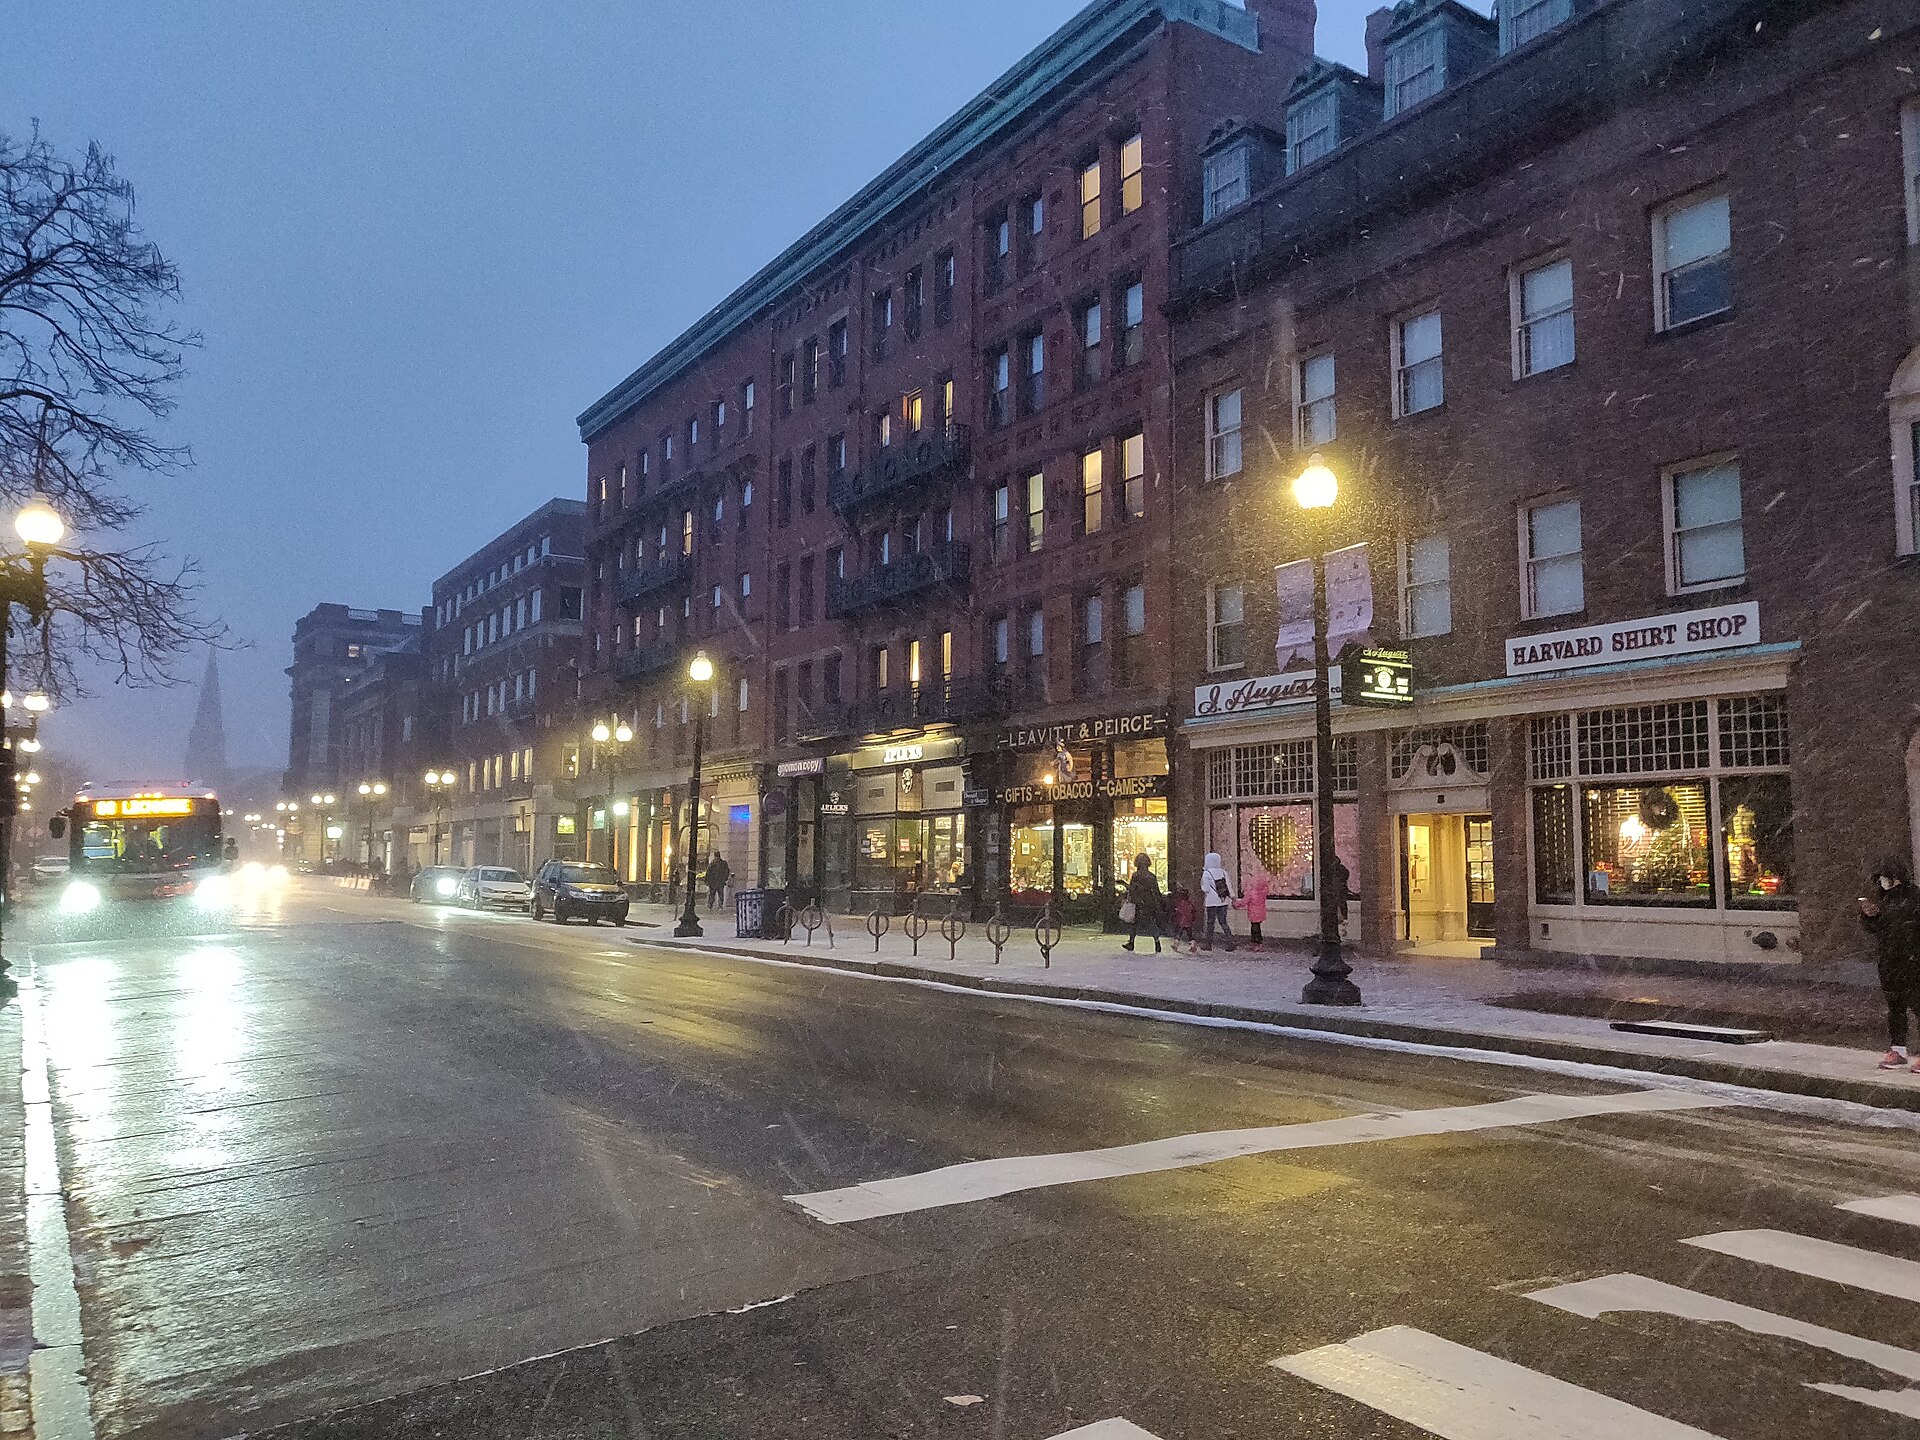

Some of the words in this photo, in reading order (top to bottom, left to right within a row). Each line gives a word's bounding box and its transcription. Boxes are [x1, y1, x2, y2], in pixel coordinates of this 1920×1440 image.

[1513, 636, 1603, 665] HARVARD
[1611, 624, 1677, 652] SHIRT
[1686, 613, 1748, 642] SHOP
[1225, 679, 1317, 709] Augus
[1009, 725, 1074, 748] LEAVITT
[1079, 722, 1090, 739] &
[1094, 714, 1153, 737] PEIRCE
[1005, 786, 1032, 803] GIFTS
[1047, 781, 1093, 801] TOBACCO
[1106, 777, 1146, 797] GAMES
